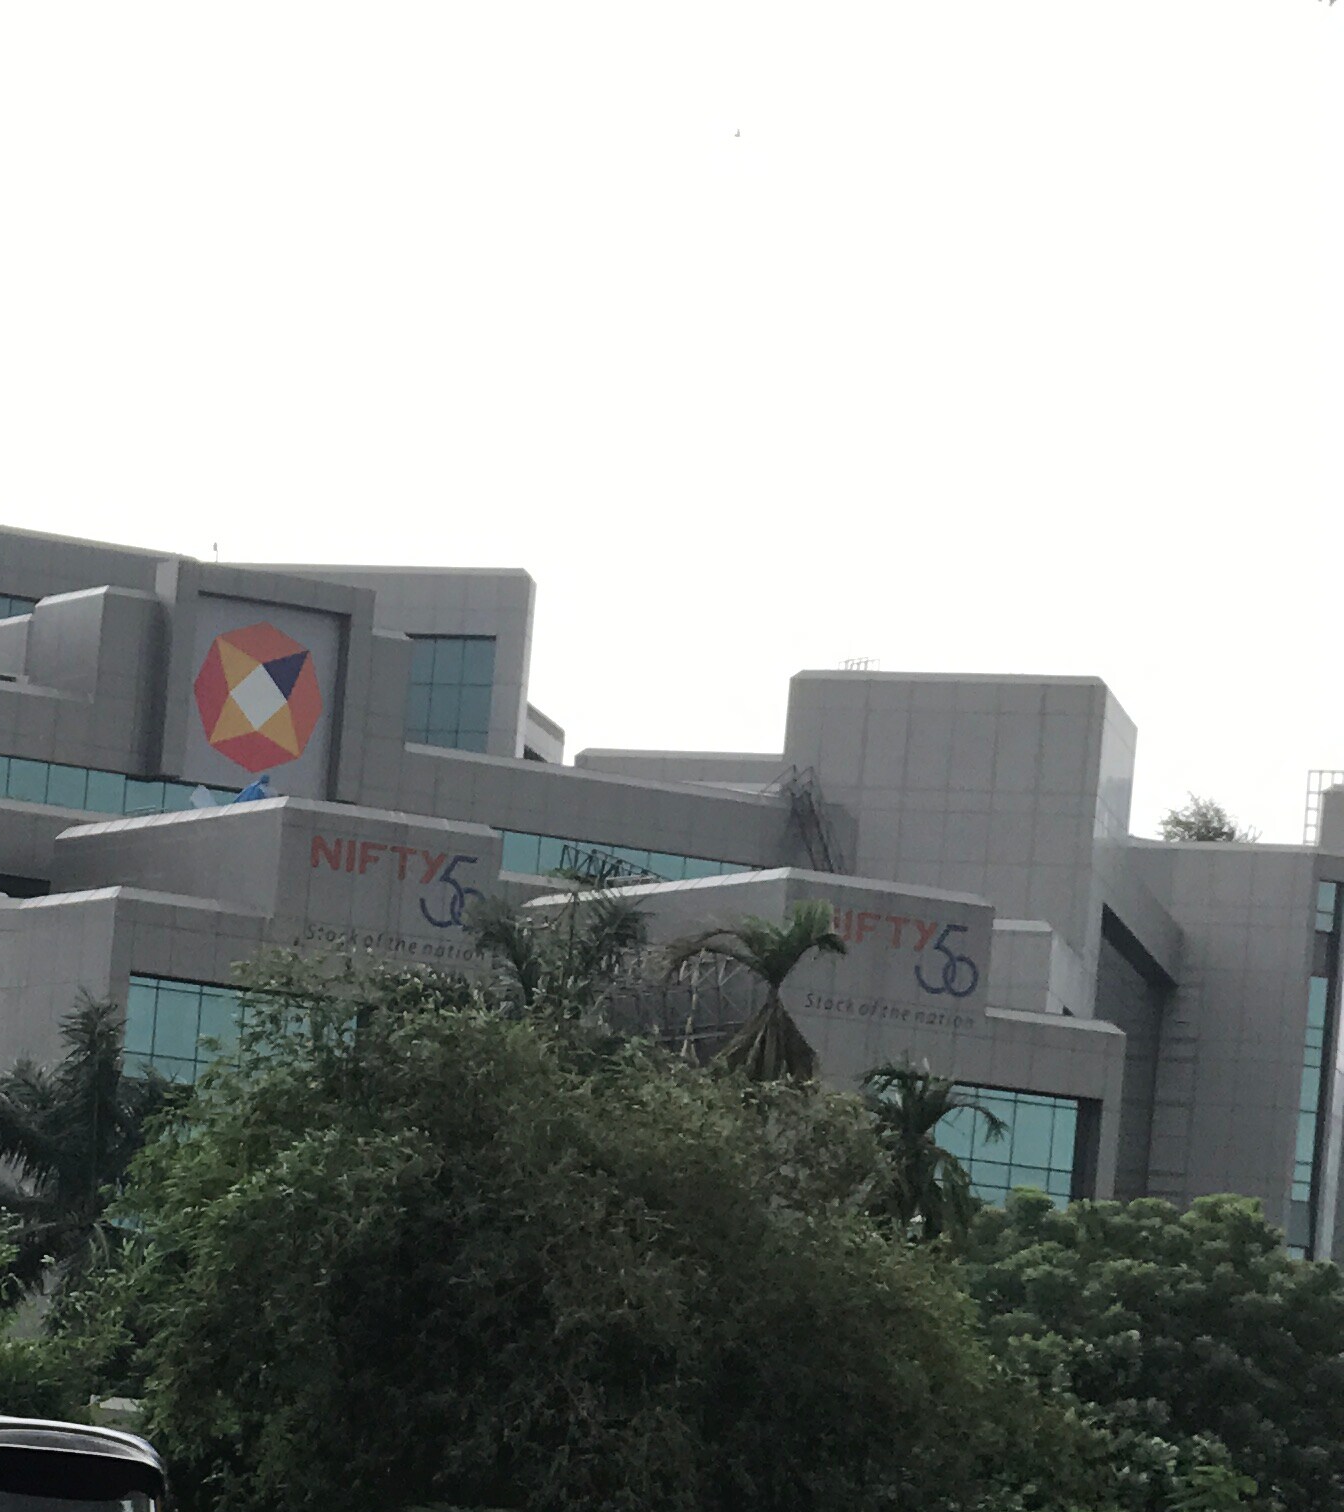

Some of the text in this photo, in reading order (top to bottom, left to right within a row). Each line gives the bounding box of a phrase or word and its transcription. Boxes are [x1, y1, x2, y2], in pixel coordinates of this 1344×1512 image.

[310, 834, 448, 885] NIFTY
[363, 932, 386, 949] of
[387, 934, 417, 955] the
[914, 924, 979, 998] 50
[858, 998, 880, 1017] of
